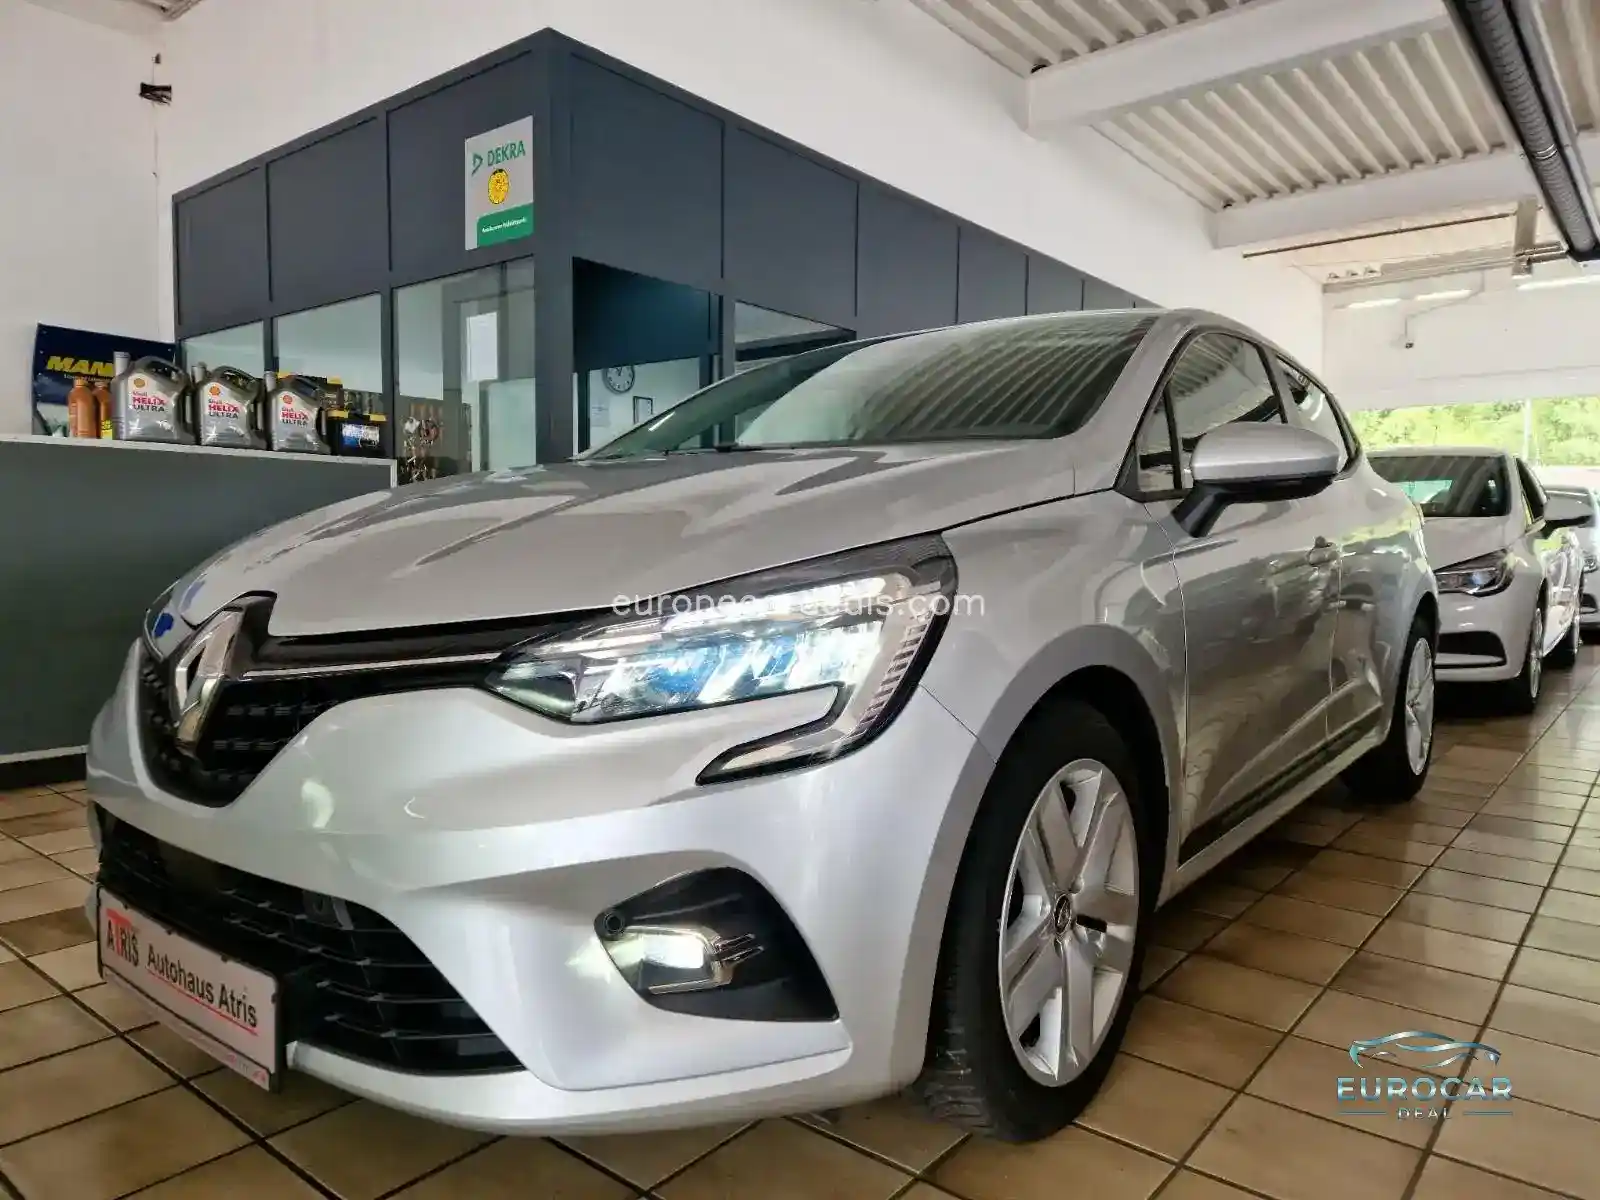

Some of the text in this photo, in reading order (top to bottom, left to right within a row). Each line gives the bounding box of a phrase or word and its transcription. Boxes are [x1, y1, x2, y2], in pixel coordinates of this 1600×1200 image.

[487, 140, 525, 166] DEKRA
[47, 356, 114, 377] MAN
[132, 396, 166, 406] HELIX
[133, 404, 165, 412] ULTRA
[208, 404, 240, 413] HELIX
[281, 411, 308, 420] HELIX
[281, 419, 308, 427] ULTRA
[147, 944, 214, 1004] Autohaus
[219, 984, 257, 1027] Atris
